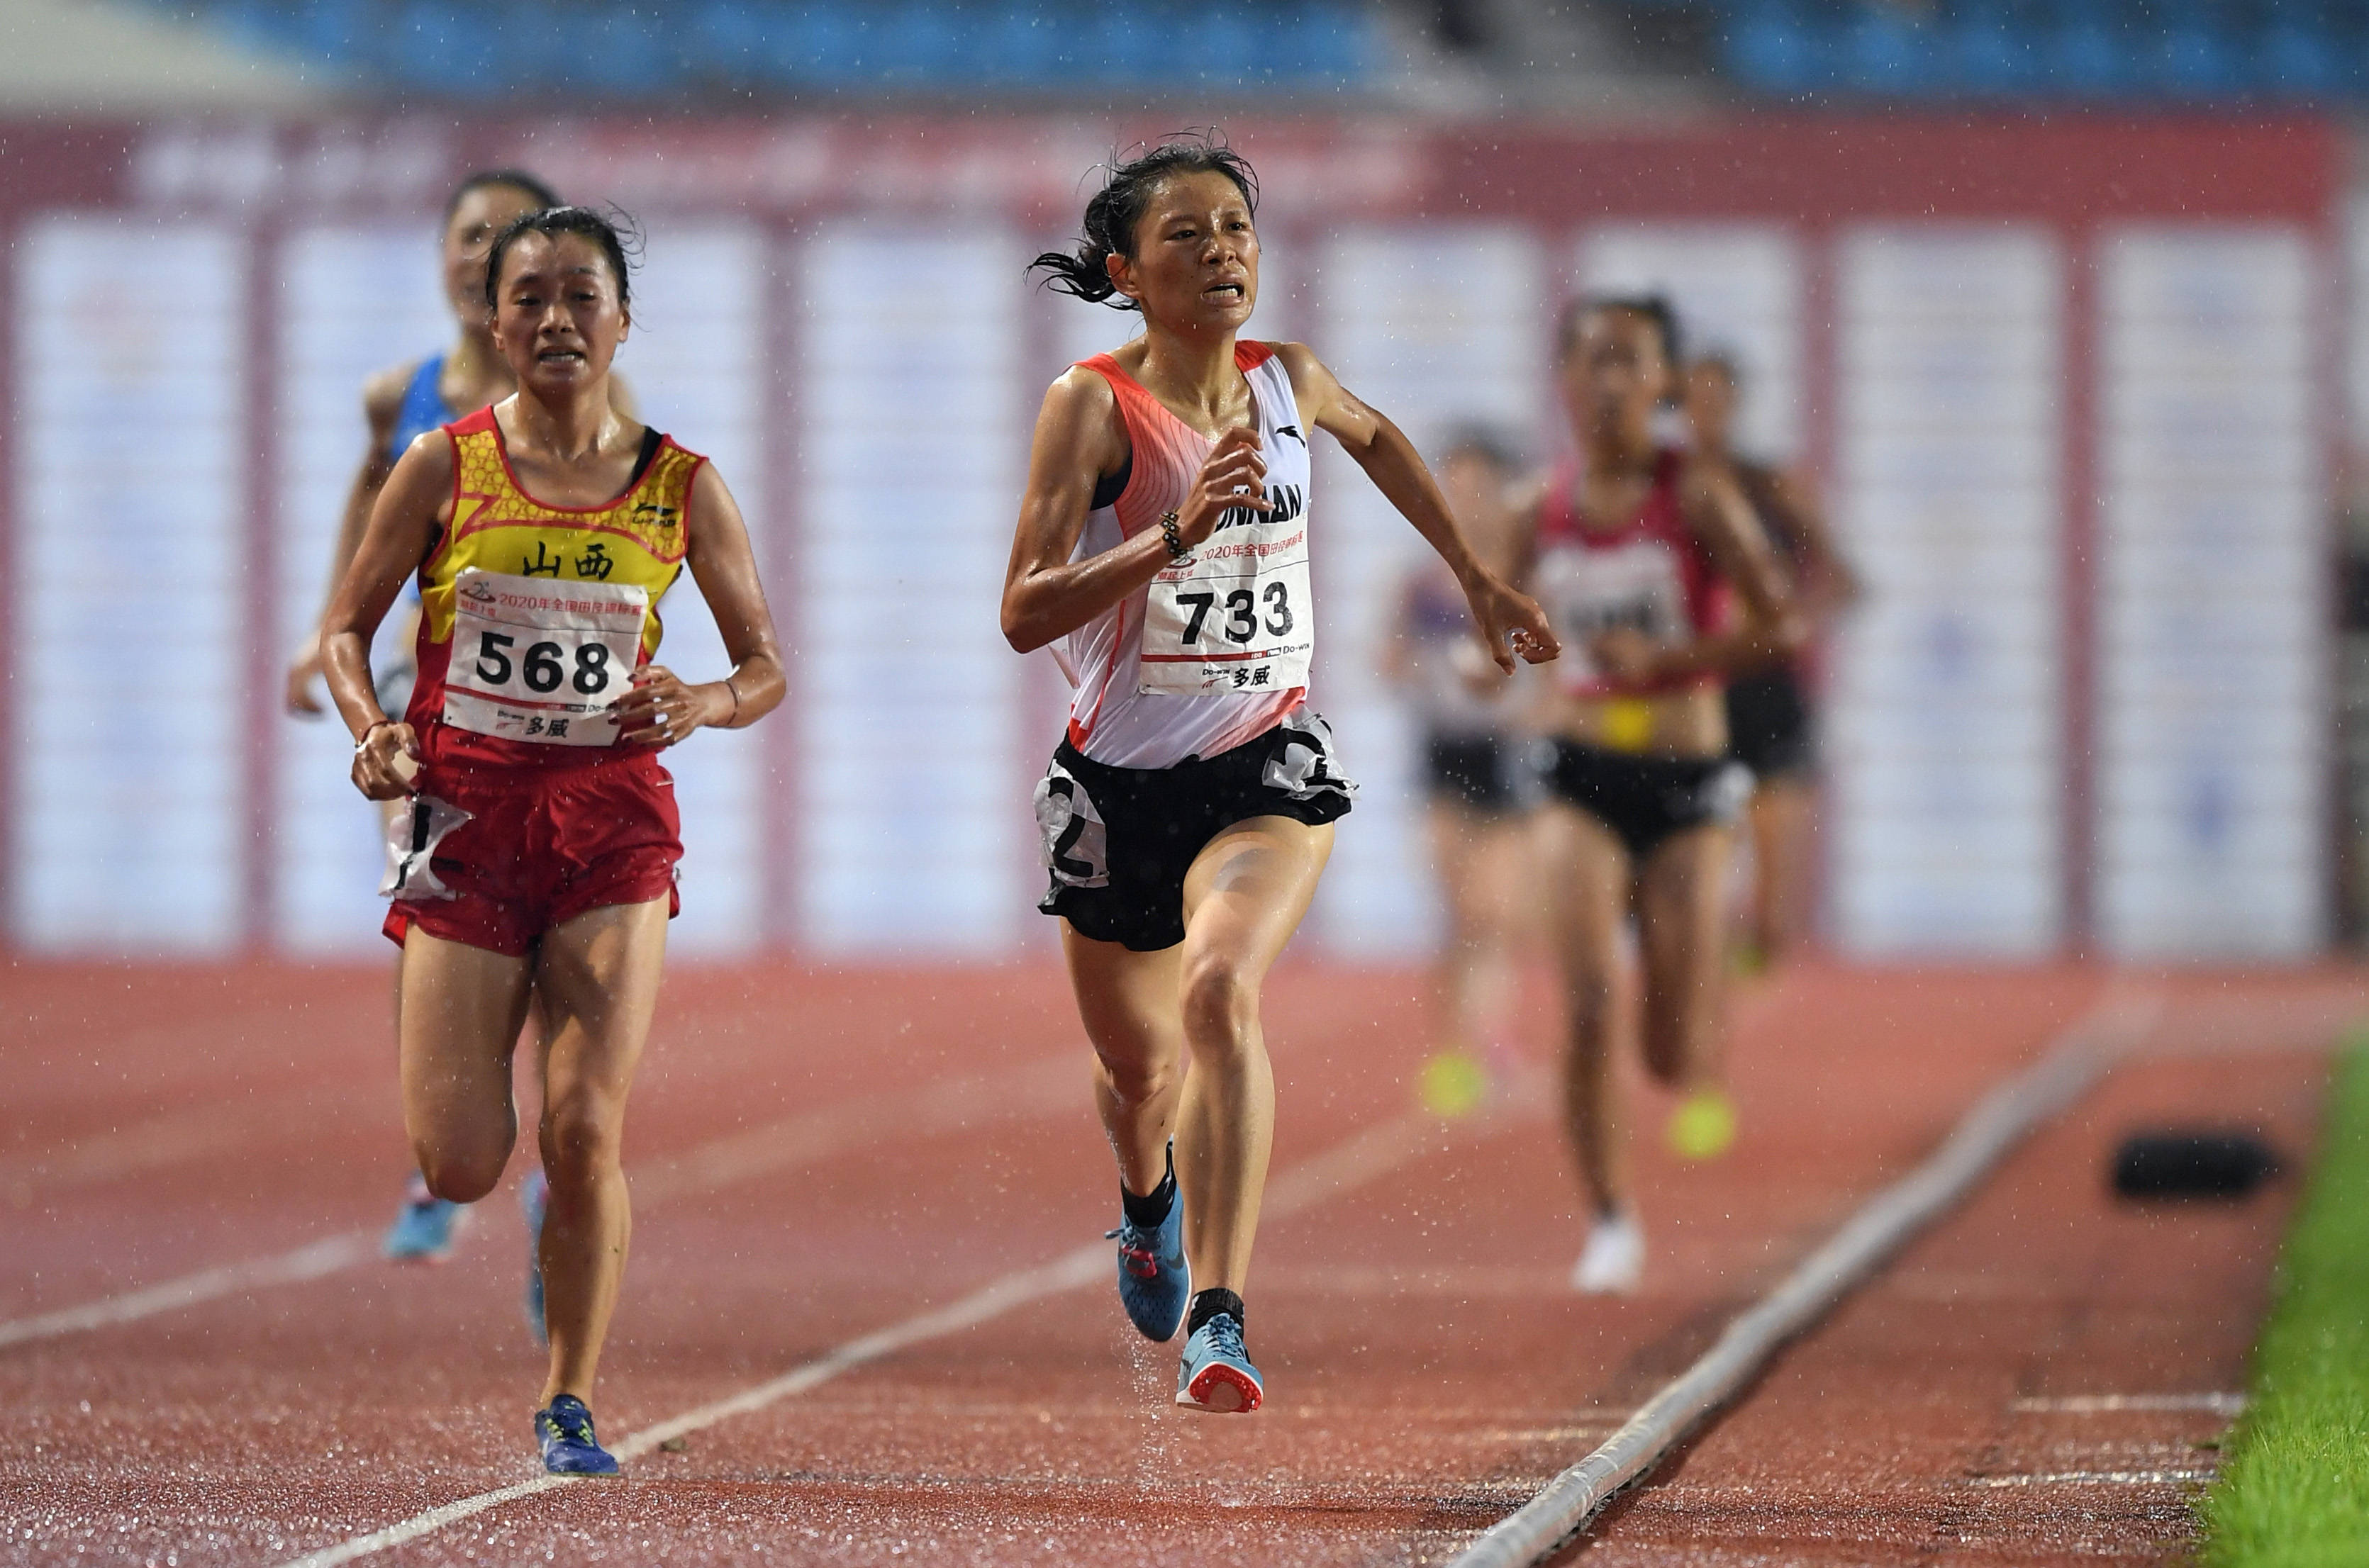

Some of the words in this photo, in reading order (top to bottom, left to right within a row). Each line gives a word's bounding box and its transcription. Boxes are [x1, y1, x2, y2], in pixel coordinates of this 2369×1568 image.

[523, 541, 613, 581] 山西
[1176, 581, 1293, 645] 733
[476, 631, 609, 695] 568
[1232, 665, 1271, 688] 多威
[525, 716, 570, 739] 多威
[1047, 776, 1094, 878] 2
